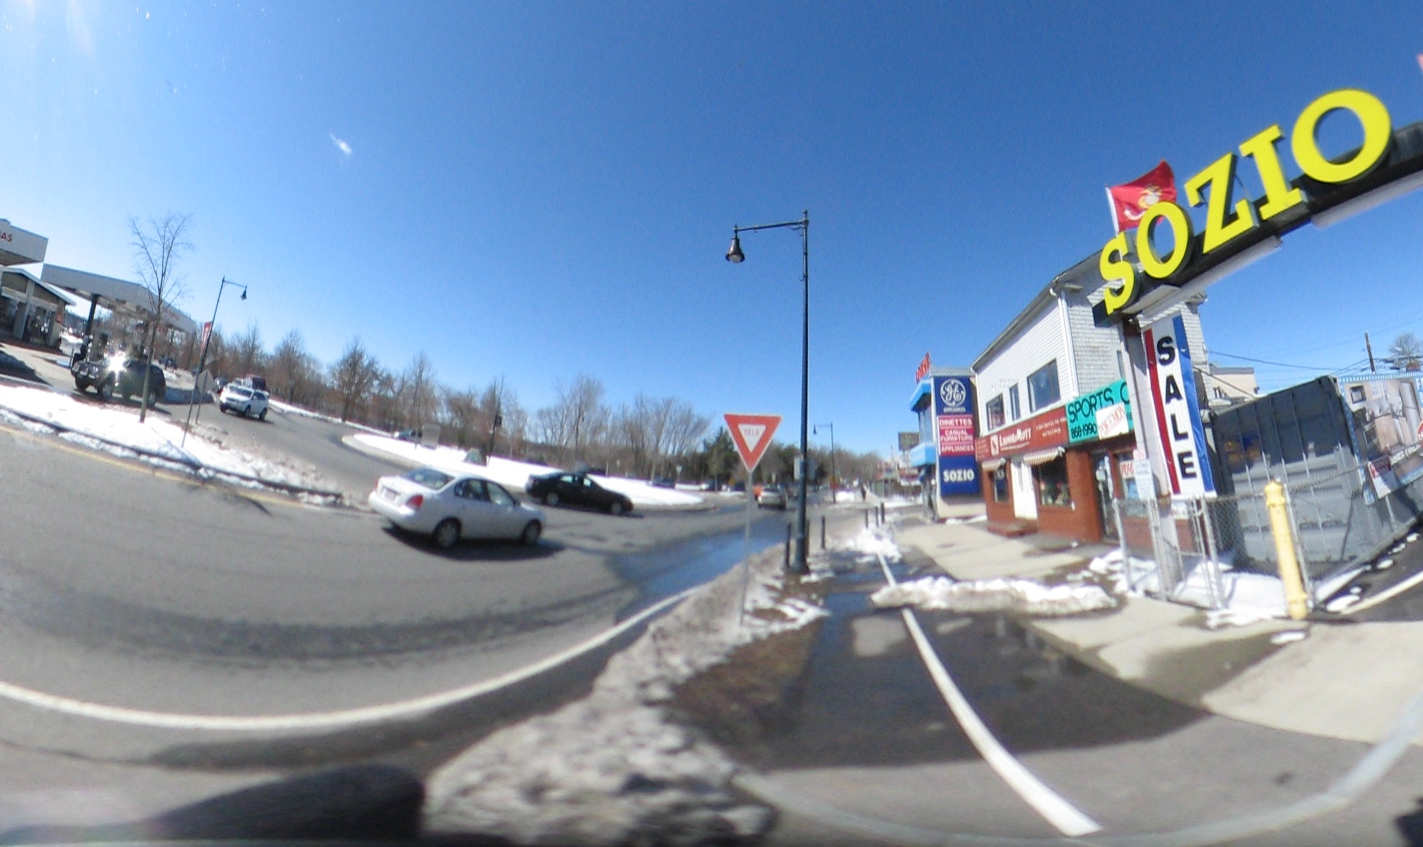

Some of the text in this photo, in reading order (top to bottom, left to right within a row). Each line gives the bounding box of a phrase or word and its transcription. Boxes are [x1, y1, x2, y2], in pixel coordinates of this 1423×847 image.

[1099, 89, 1392, 315] SOZIO
[1067, 387, 1114, 423] SPORTS
[1156, 336, 1197, 479] SALE
[943, 469, 975, 483] SOZIO
